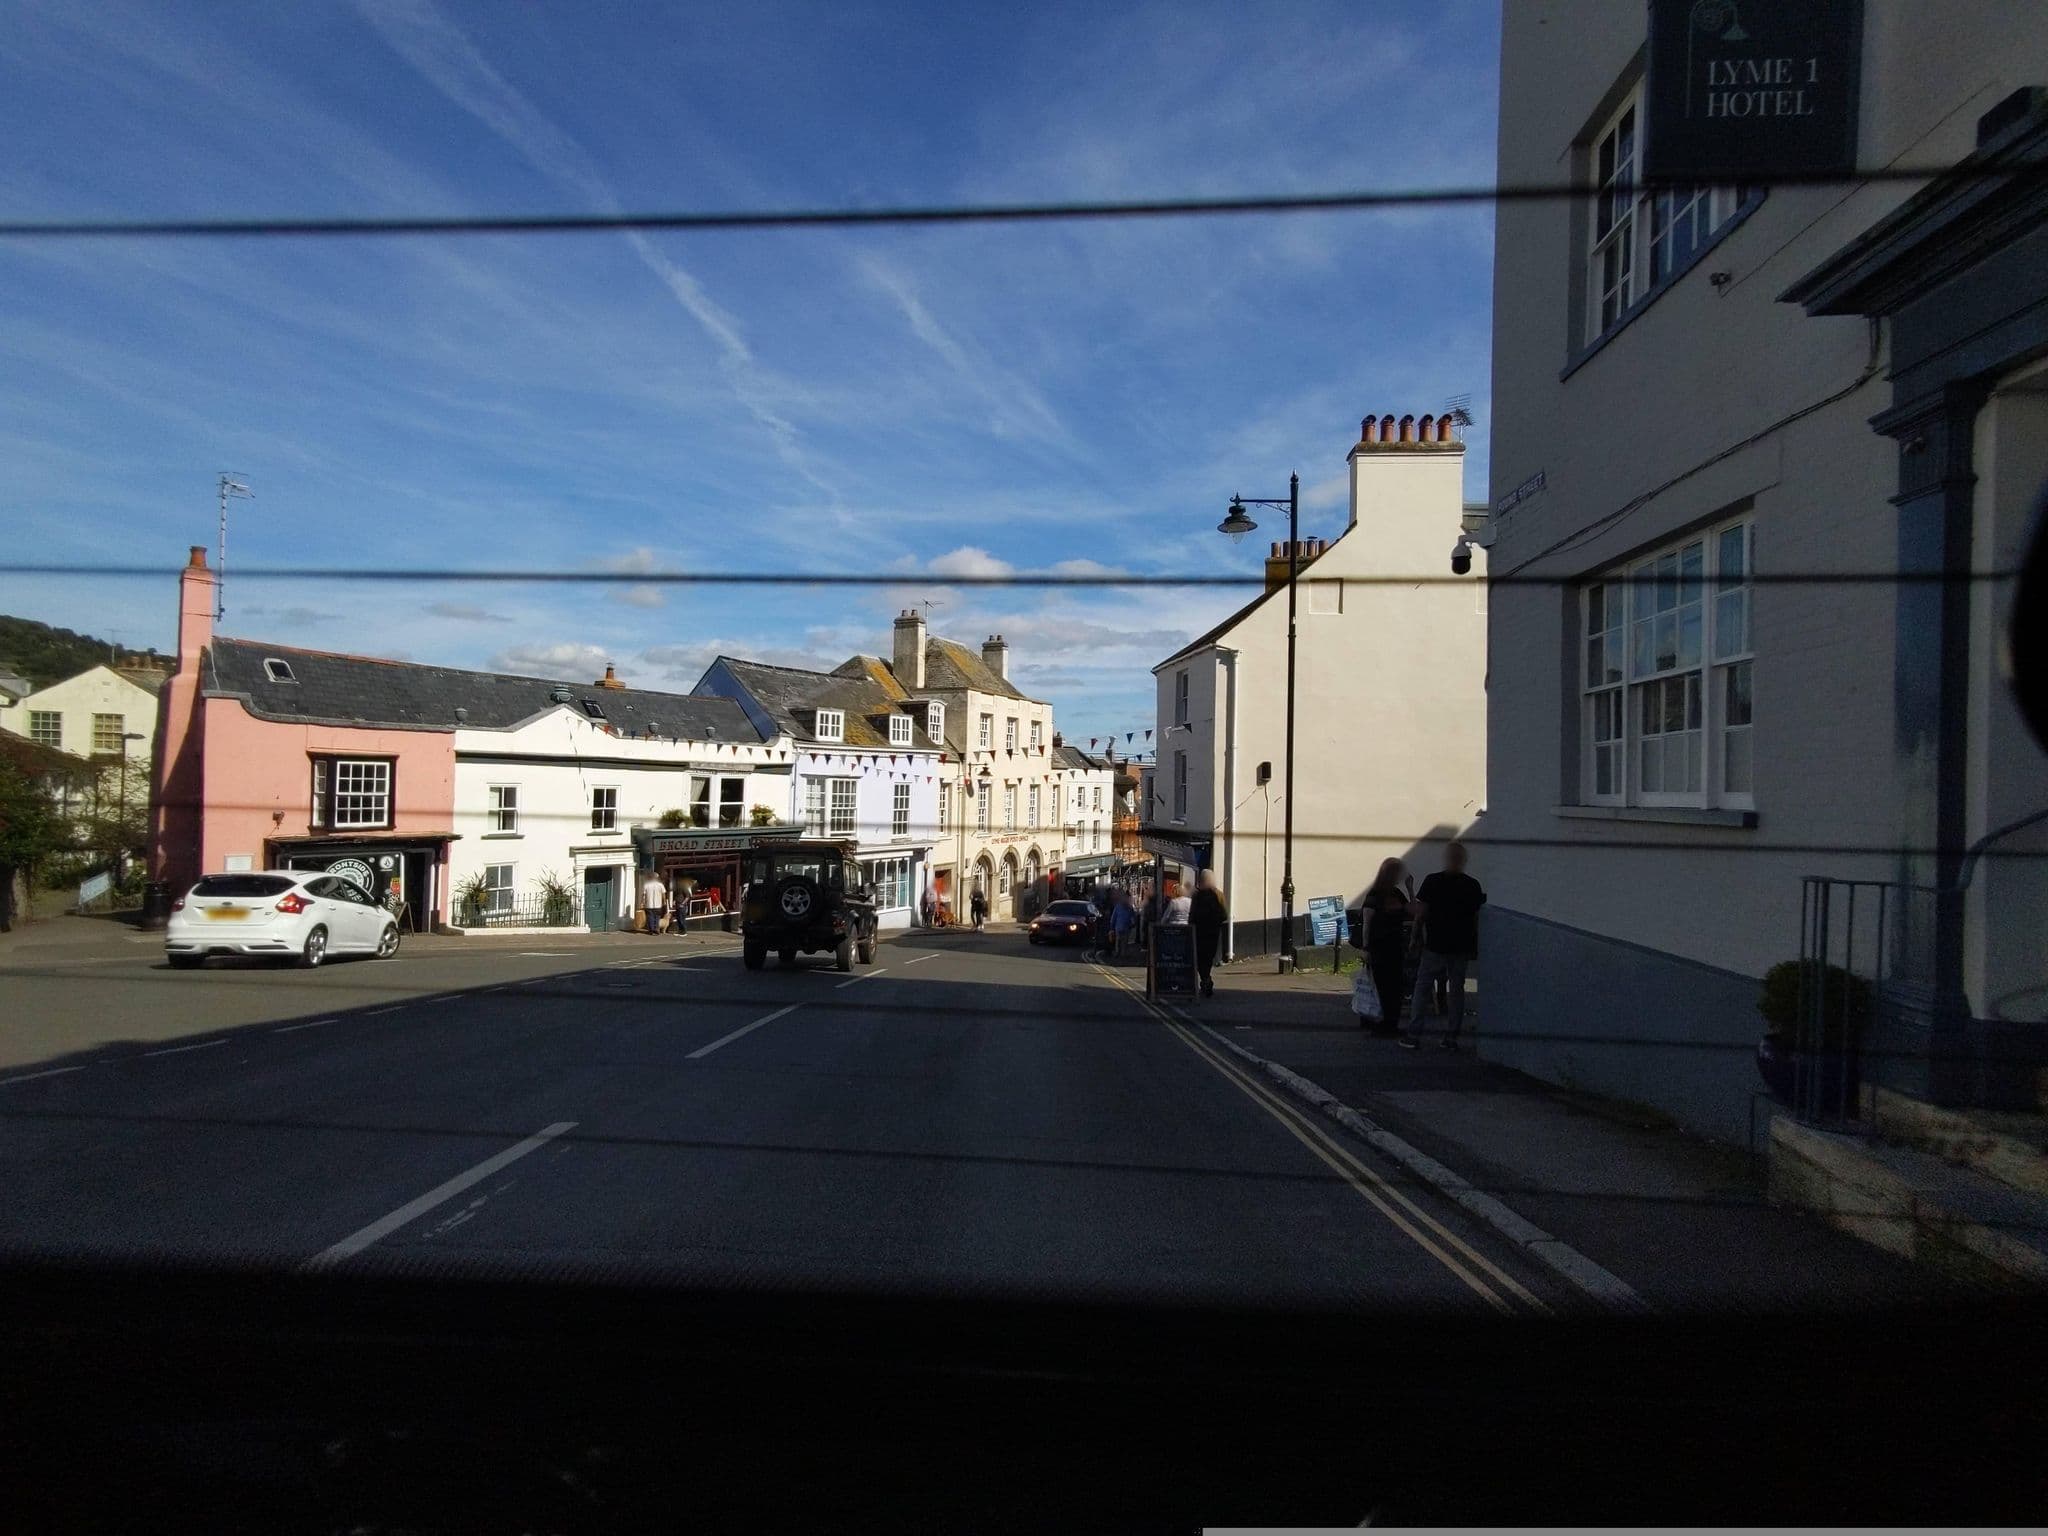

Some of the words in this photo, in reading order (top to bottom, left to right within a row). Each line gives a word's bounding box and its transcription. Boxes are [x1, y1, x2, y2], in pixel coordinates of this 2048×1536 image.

[1708, 58, 1793, 86] LYME
[1807, 57, 1819, 83] 1
[1706, 90, 1814, 117] HOTEL
[659, 840, 698, 851] BROAD
[703, 839, 745, 850] STREET
[329, 861, 370, 877] RONTSIDE
